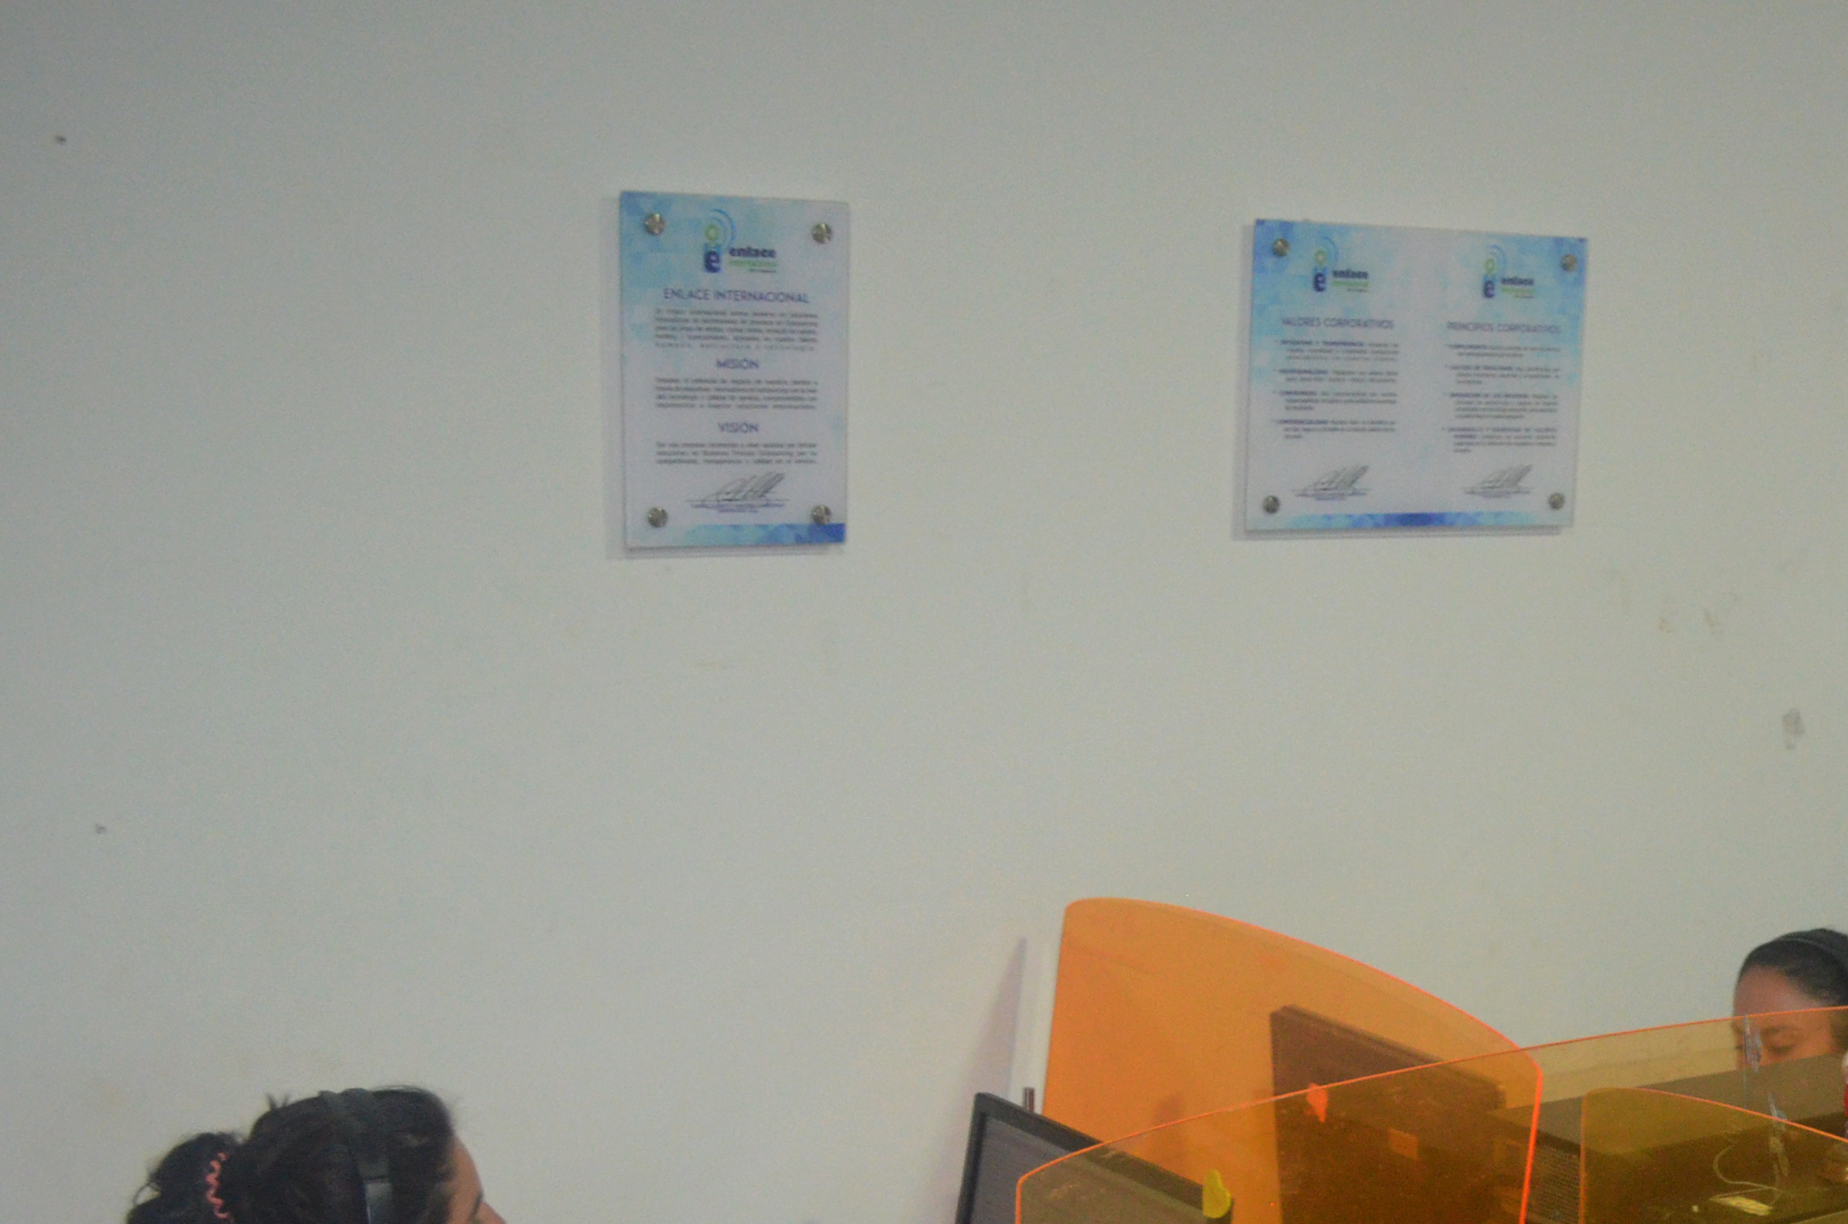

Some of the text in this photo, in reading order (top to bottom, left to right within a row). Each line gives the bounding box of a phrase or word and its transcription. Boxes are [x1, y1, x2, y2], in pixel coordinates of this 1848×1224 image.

[729, 246, 777, 258] enlace
[663, 288, 809, 304] ENLACE INTERNACIONAL
[1282, 316, 1395, 329] VALORES CORPORATIVOS
